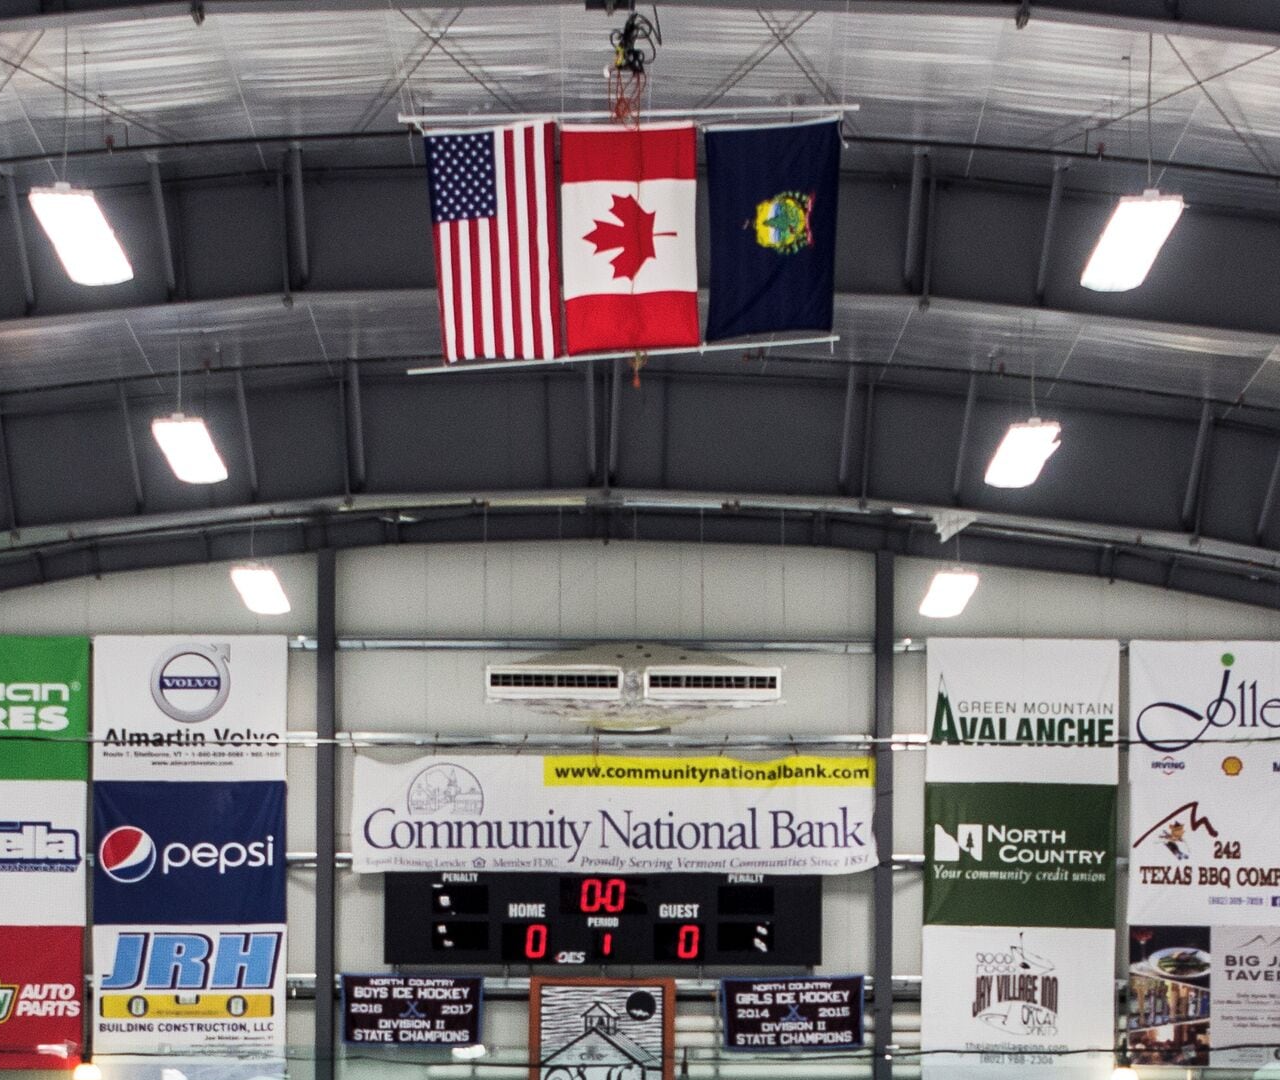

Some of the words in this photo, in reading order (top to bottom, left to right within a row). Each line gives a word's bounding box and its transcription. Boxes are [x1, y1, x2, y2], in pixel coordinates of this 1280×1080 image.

[162, 677, 218, 688] VOLVO
[958, 701, 1018, 714] GREEN
[1023, 702, 1114, 714] MOUNTAIN
[930, 690, 1114, 748] AVALANCHE
[104, 728, 205, 747] Almartin
[214, 728, 280, 747] Volvo
[1151, 761, 1185, 769] IRVING
[555, 764, 869, 782] www.communitynationalbank.com
[363, 807, 592, 861] Community
[600, 808, 759, 850] National
[769, 808, 865, 850] Bank
[987, 825, 1066, 844] NORTH
[162, 836, 274, 874] pepsi
[999, 846, 1106, 864] COUNTRY
[1214, 841, 1241, 859] 242
[434, 857, 466, 867] Lender
[493, 857, 531, 868] Member
[580, 856, 626, 870] Proudly
[628, 857, 672, 870] Serving
[677, 857, 726, 868] Vermont
[729, 857, 807, 868] Communities
[810, 856, 839, 867] Since
[442, 873, 479, 882] PENALTY
[728, 874, 764, 883] PENALTY
[933, 865, 961, 880] Your
[964, 867, 1032, 884] community
[1036, 867, 1069, 881] credit
[1073, 870, 1106, 881] union
[1140, 866, 1192, 885] TEXAS
[1198, 867, 1231, 888] BBQ
[508, 904, 546, 918] HOME
[659, 904, 699, 919] GUEST
[587, 917, 619, 927] PERIOD
[525, 925, 548, 959] 0
[604, 933, 612, 955] 1
[677, 925, 699, 959] 0
[100, 932, 282, 990] JRH
[1225, 955, 1260, 967] BIG
[370, 978, 404, 986] NORTH
[408, 979, 455, 987] COUNTRY
[753, 983, 786, 992] NORTH
[788, 982, 832, 991] COUNTRY
[22, 984, 75, 999] AUTO
[353, 986, 388, 999] BOYS
[393, 988, 413, 999] ICE
[418, 987, 469, 999] HOCKEY
[735, 993, 773, 1005] GIRLS
[776, 992, 796, 1004] ICE
[799, 991, 850, 1003] HOCKEY
[972, 975, 993, 1018] JAY
[997, 974, 1038, 1004] VILLAGE
[16, 1001, 80, 1016] PARTS
[441, 1004, 473, 1015] 2017
[737, 1009, 770, 1018] 2014
[99, 1023, 154, 1032] BUILDING
[158, 1023, 251, 1034] CONSTRUCTION,
[253, 1023, 274, 1032] LLC
[378, 1019, 431, 1029] DIVISION
[436, 1020, 445, 1029] II
[761, 1022, 813, 1032] DIVISION
[817, 1022, 826, 1031] II
[353, 1030, 393, 1041] STATE
[399, 1030, 470, 1042] CHAMPIONS
[736, 1034, 776, 1045] STATE
[780, 1031, 853, 1044] CHAMPIONS
